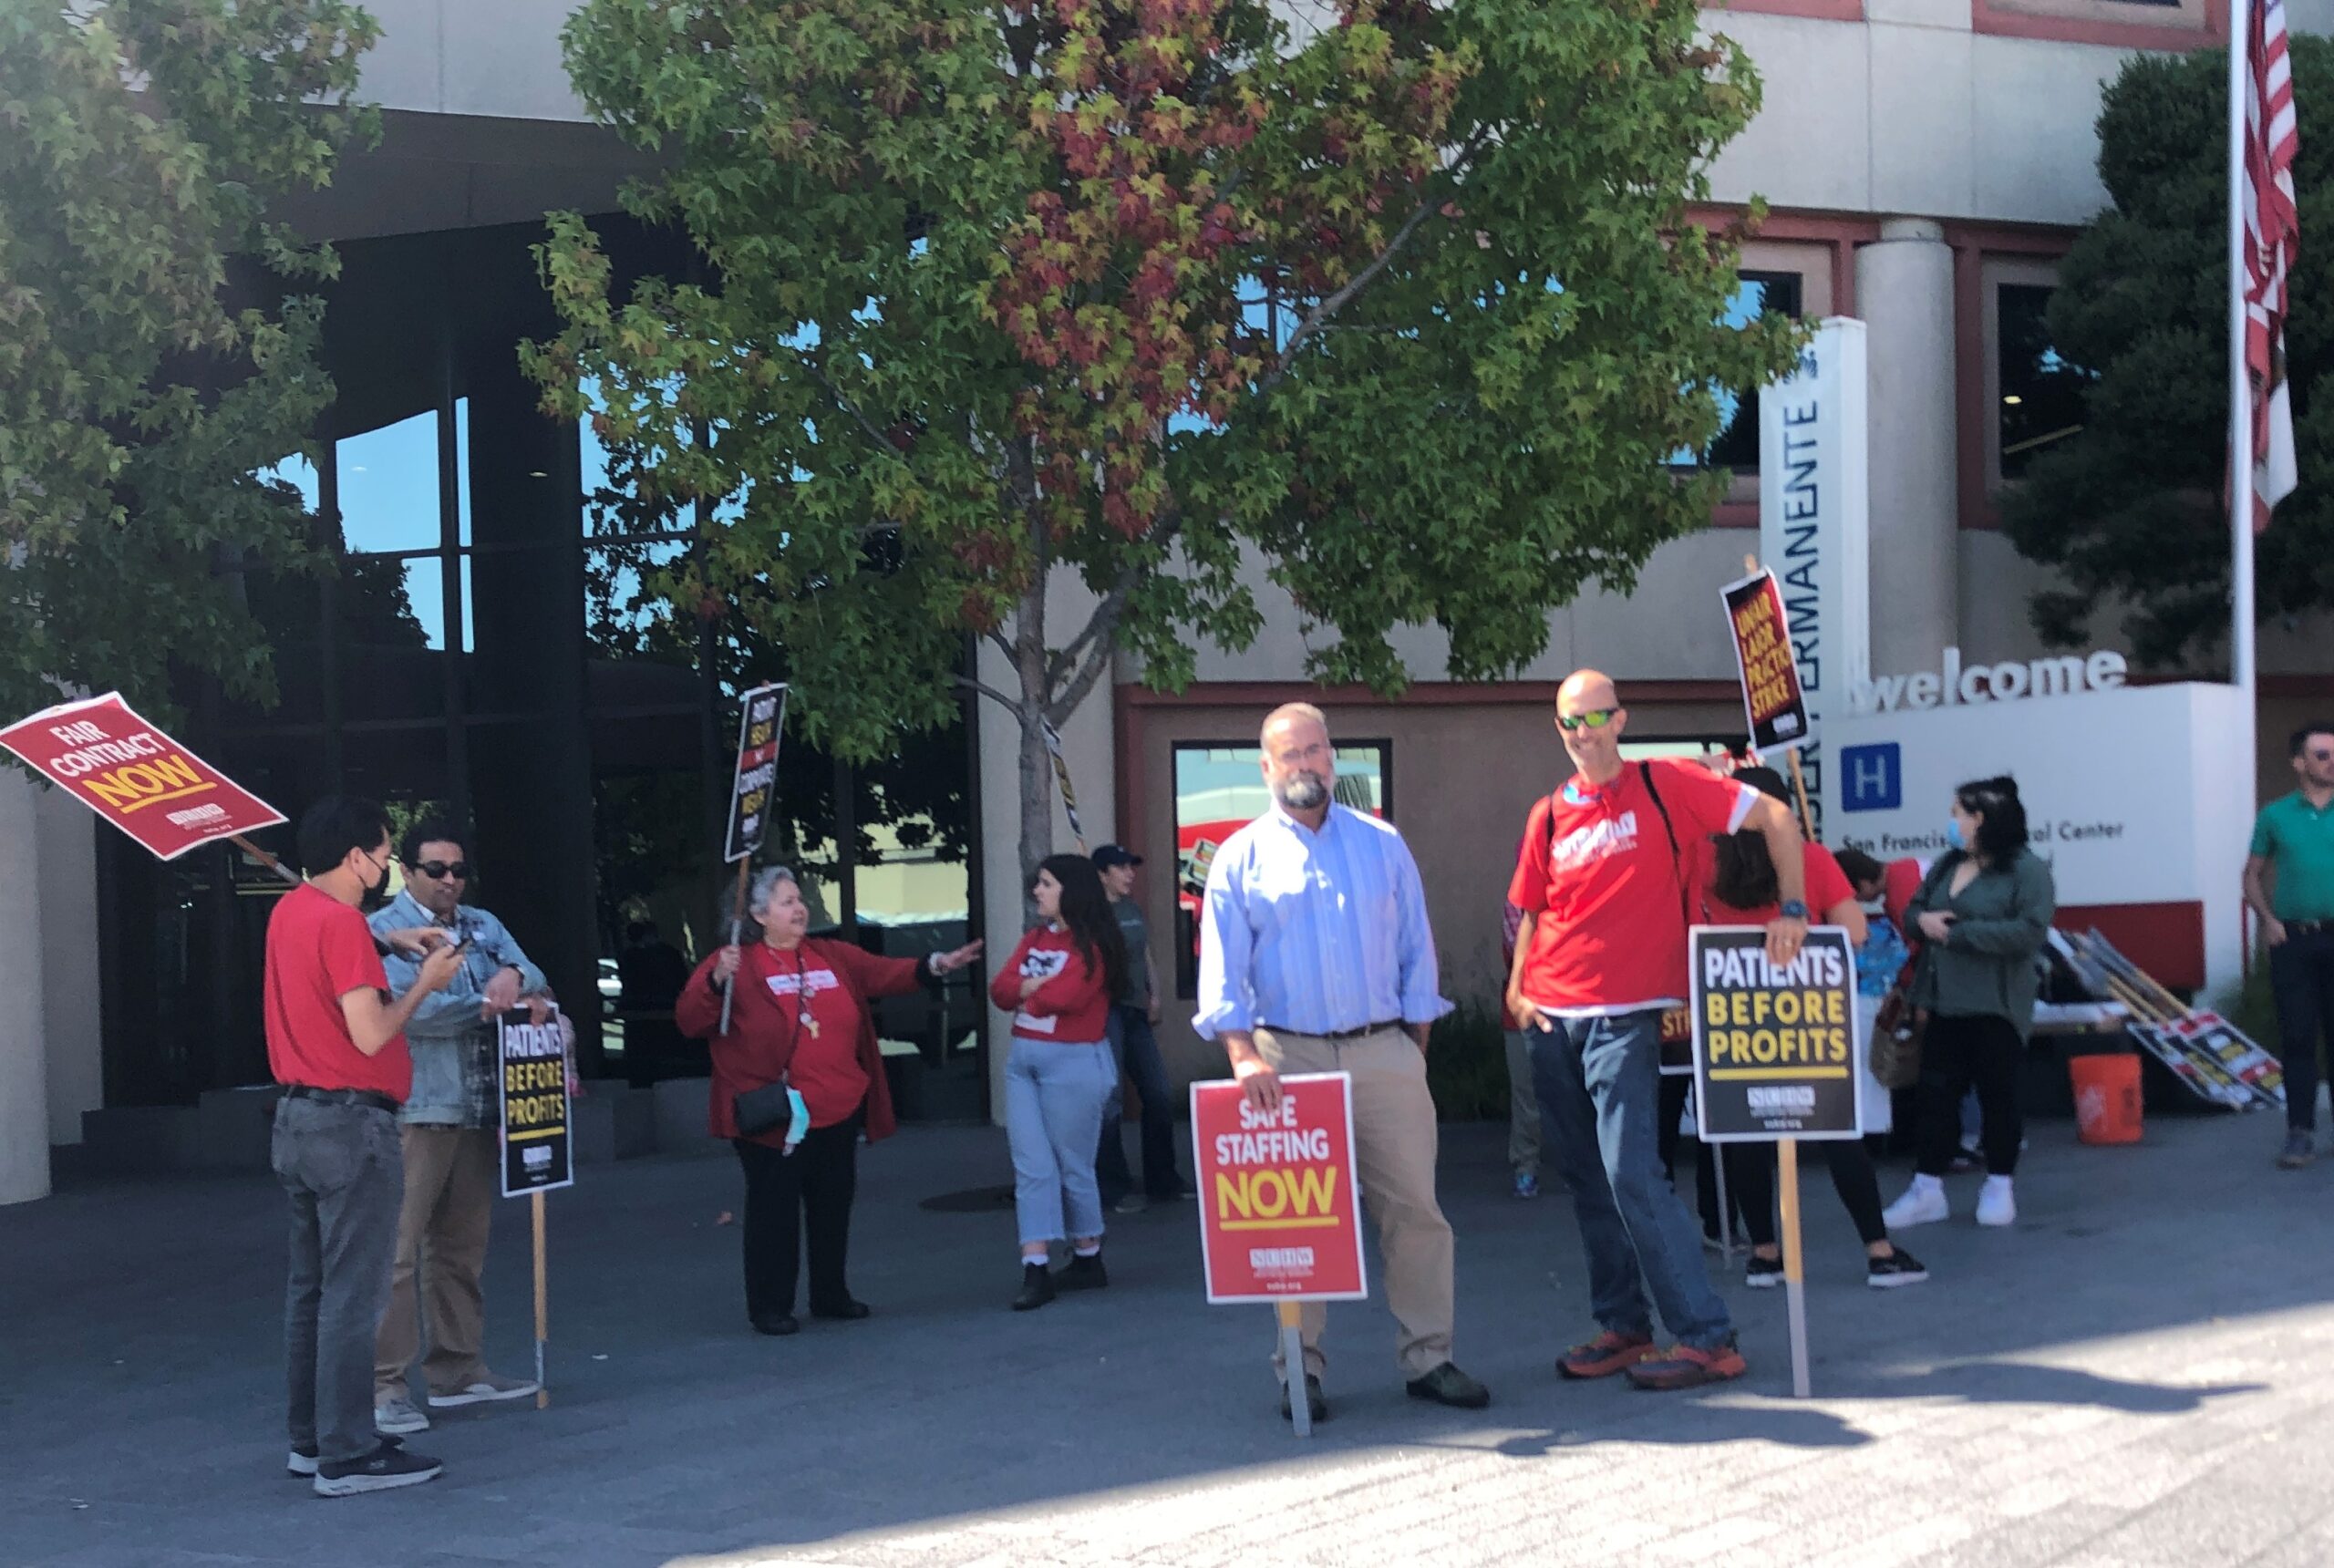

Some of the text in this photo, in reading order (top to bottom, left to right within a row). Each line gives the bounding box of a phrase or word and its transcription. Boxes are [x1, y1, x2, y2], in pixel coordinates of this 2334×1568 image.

[1783, 401, 1819, 723] ERMANENTE
[1843, 647, 2128, 713] welcome
[49, 720, 111, 747] FAIR
[49, 732, 167, 777] CONTRACT
[82, 754, 202, 807] NOW
[2057, 820, 2123, 841] Center
[1704, 946, 1844, 988] PATIENTS
[1706, 989, 1846, 1026] BEFORE
[505, 1023, 562, 1058] PATIENTS
[1708, 1027, 1848, 1064] PROFITS
[506, 1060, 563, 1093] BEFORE
[507, 1093, 564, 1126] PROFITS
[1215, 1129, 1330, 1166] STAFFING
[1215, 1165, 1337, 1220] NOW
